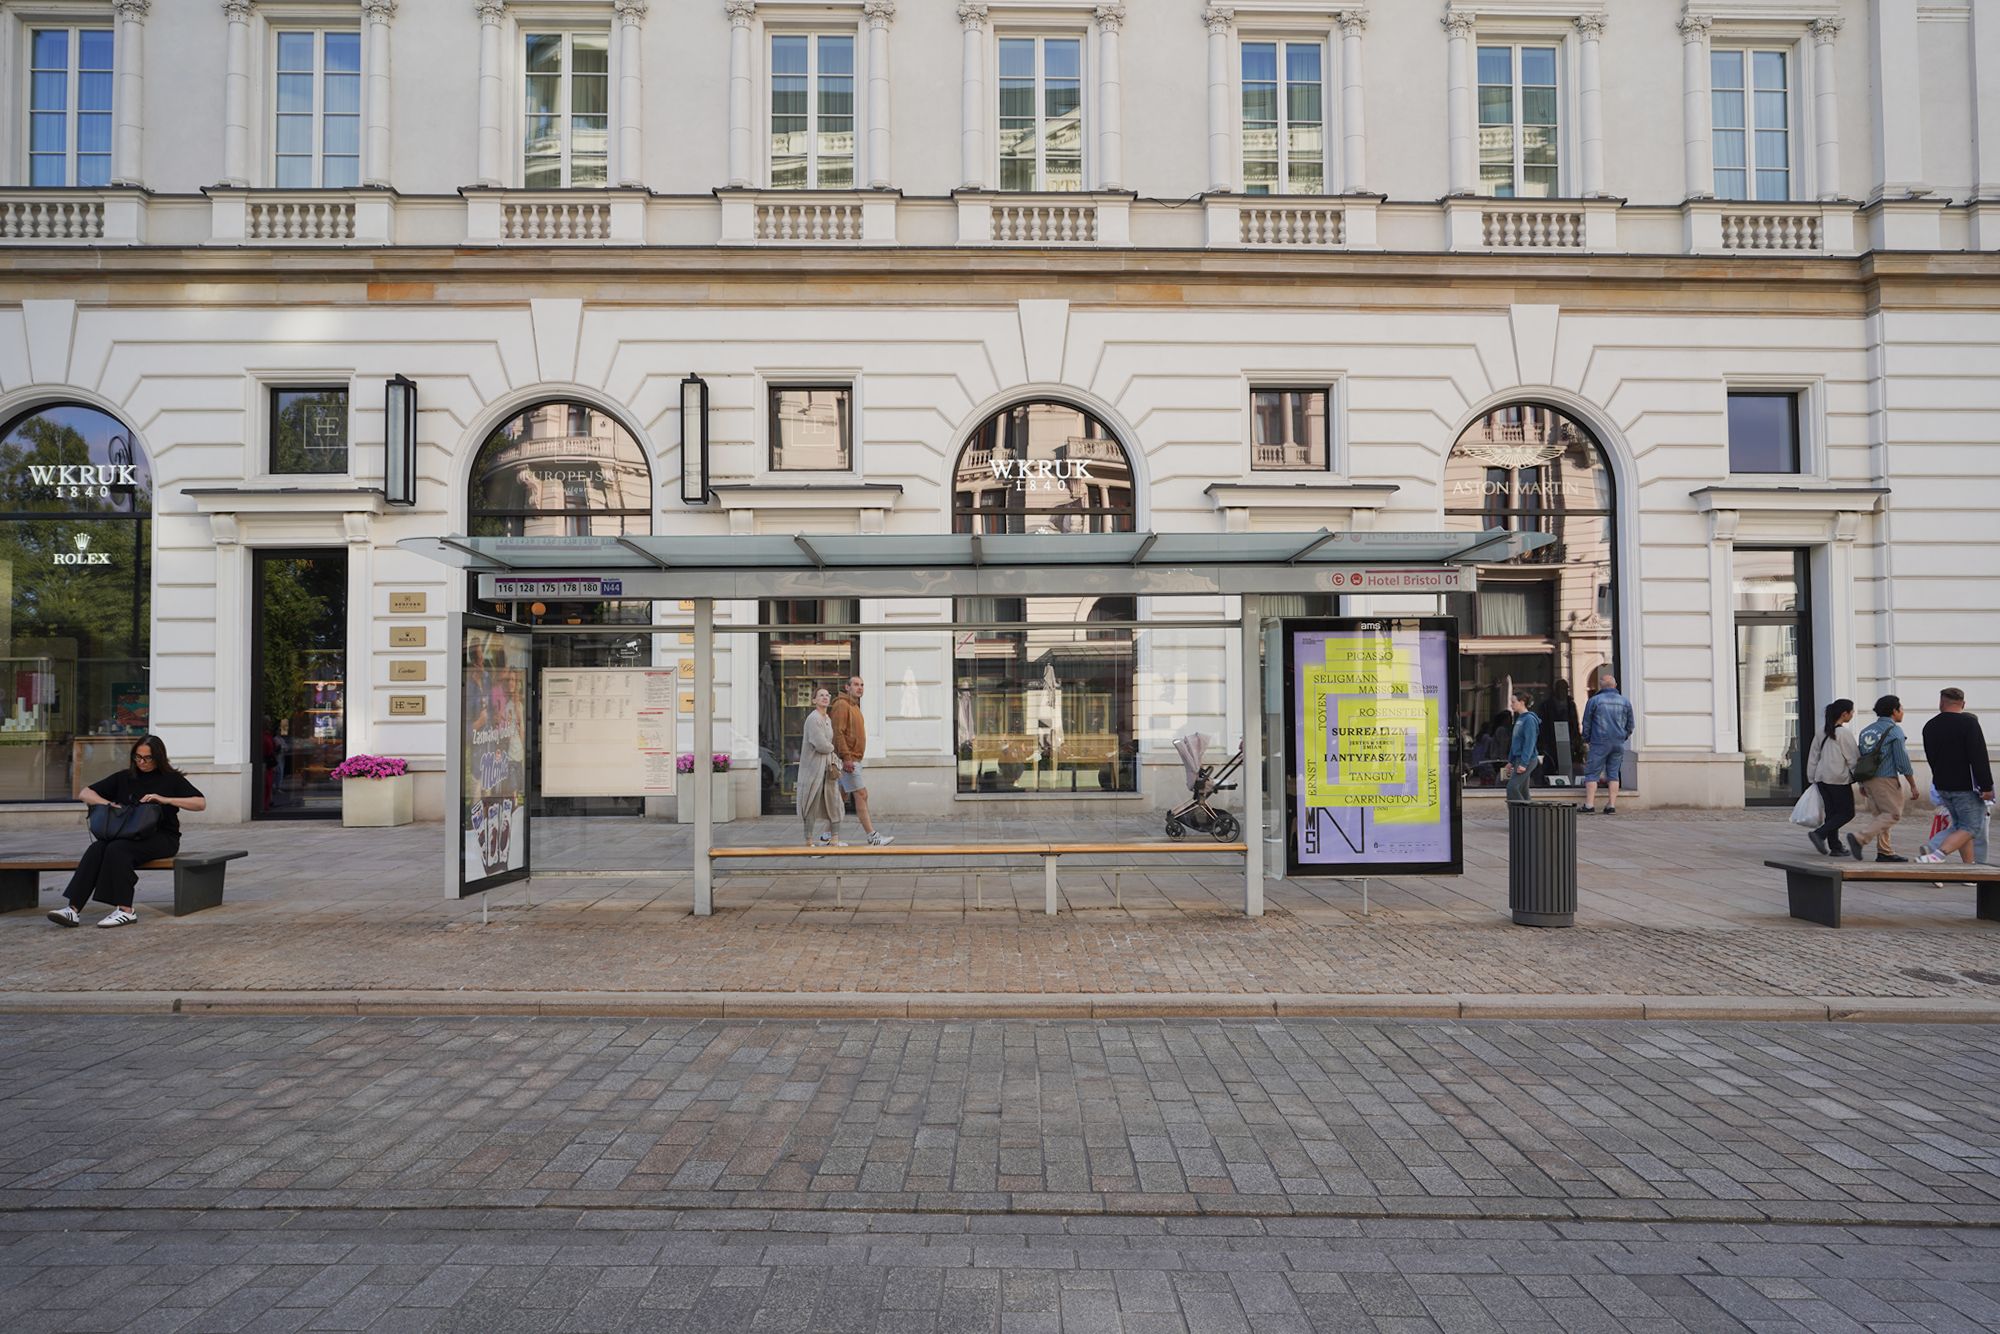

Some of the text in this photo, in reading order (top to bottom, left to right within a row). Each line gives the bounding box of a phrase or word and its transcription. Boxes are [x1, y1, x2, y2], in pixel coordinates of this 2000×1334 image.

[989, 459, 1094, 479] W.KRUK
[28, 465, 138, 486] W.KRUK
[1016, 480, 1066, 491] 1840
[1452, 481, 1579, 495] ASTON MARTIN
[56, 486, 109, 498] 1840
[53, 553, 112, 565] ROLEX
[1368, 574, 1459, 586] Hotel Bristol 01
[498, 583, 620, 593] 116 128 175 178 180 N44
[1360, 622, 1381, 630] ams
[1347, 651, 1394, 661] PICASSO
[1313, 674, 1379, 684] SELIGMANN
[1358, 685, 1404, 694] MASSON
[1318, 692, 1327, 731] TOYEN
[1359, 708, 1429, 717] ROSENSTEIN
[1331, 727, 1408, 736] SURREALIZM
[1330, 753, 1418, 762] ANTYFASZYZM
[1308, 759, 1317, 796] ERNST
[1349, 772, 1396, 781] TANGUY
[1428, 768, 1437, 807] MATTA
[1344, 795, 1418, 804] CARRINGTON
